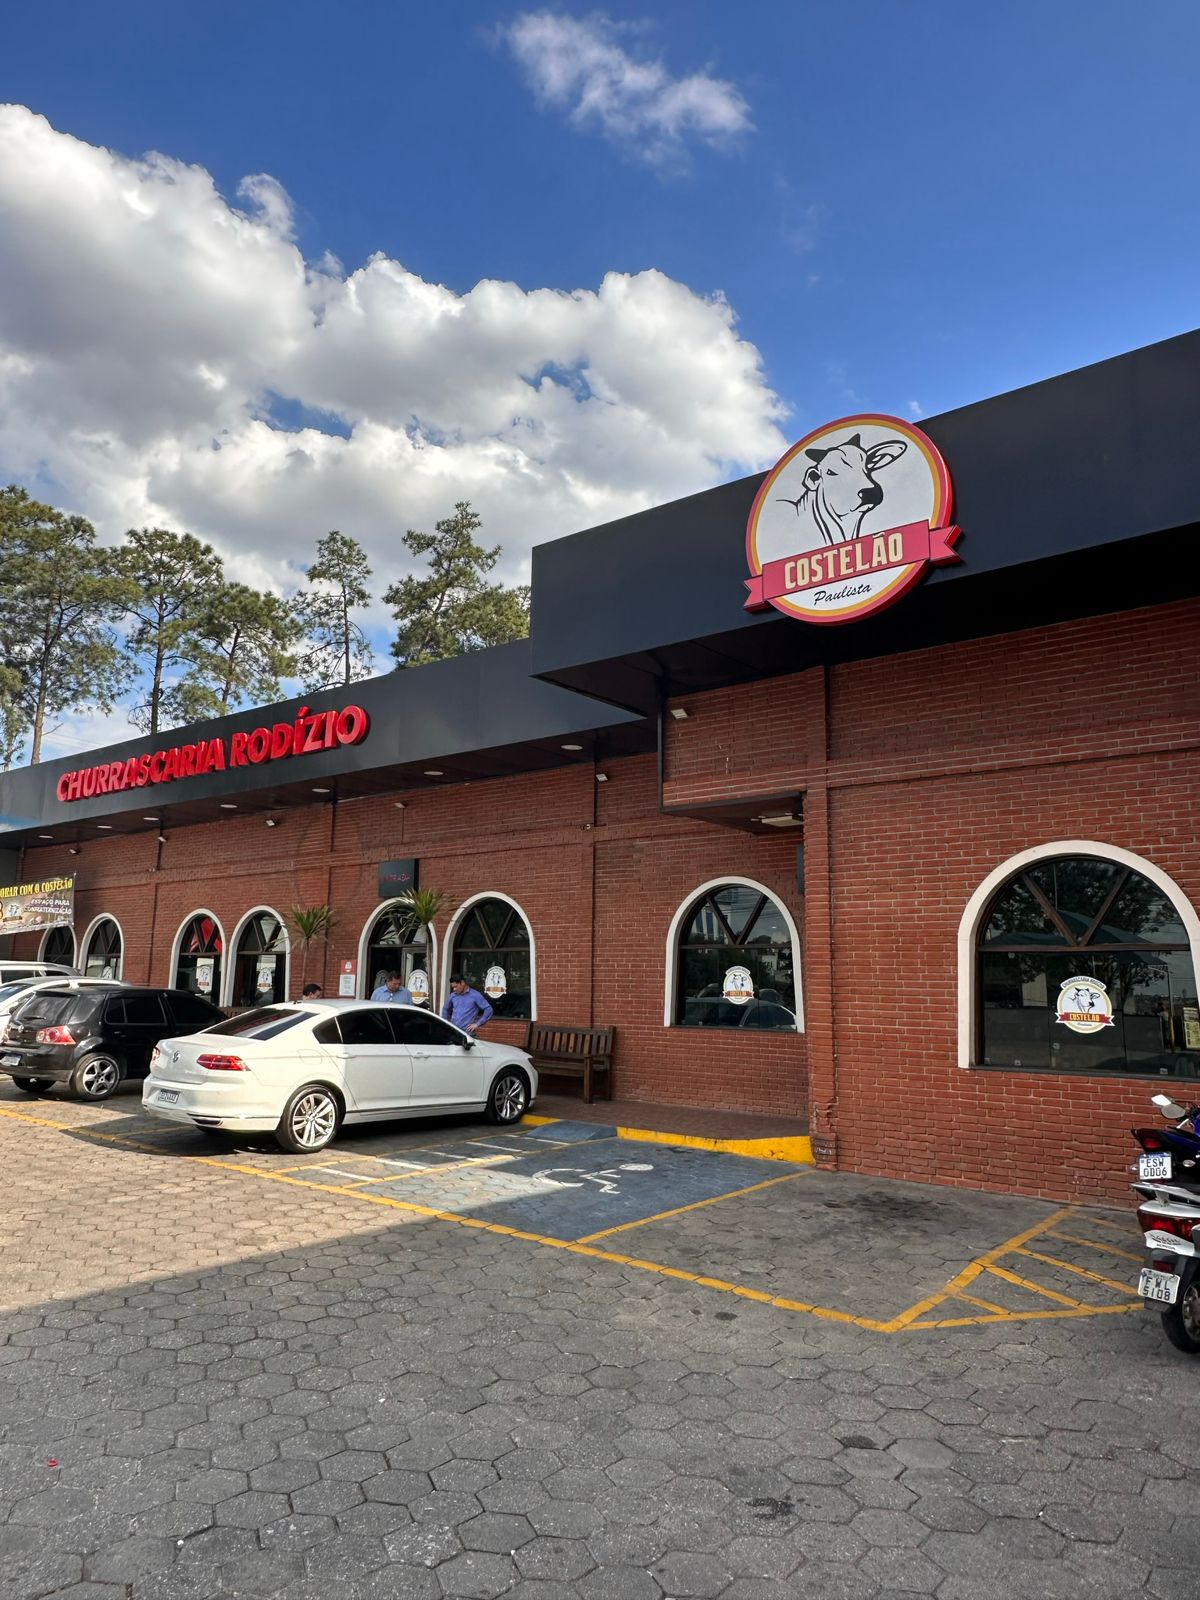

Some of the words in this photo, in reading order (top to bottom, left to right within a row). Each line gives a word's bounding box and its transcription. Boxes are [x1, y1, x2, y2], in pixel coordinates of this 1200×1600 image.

[784, 531, 903, 590] COSTELÃO
[813, 583, 872, 606] Paulista
[56, 737, 225, 802] CHURRASCARIA
[230, 705, 367, 767] RODÍZIO
[1146, 1158, 1164, 1168] ESW
[1143, 1286, 1171, 1301] 5108
